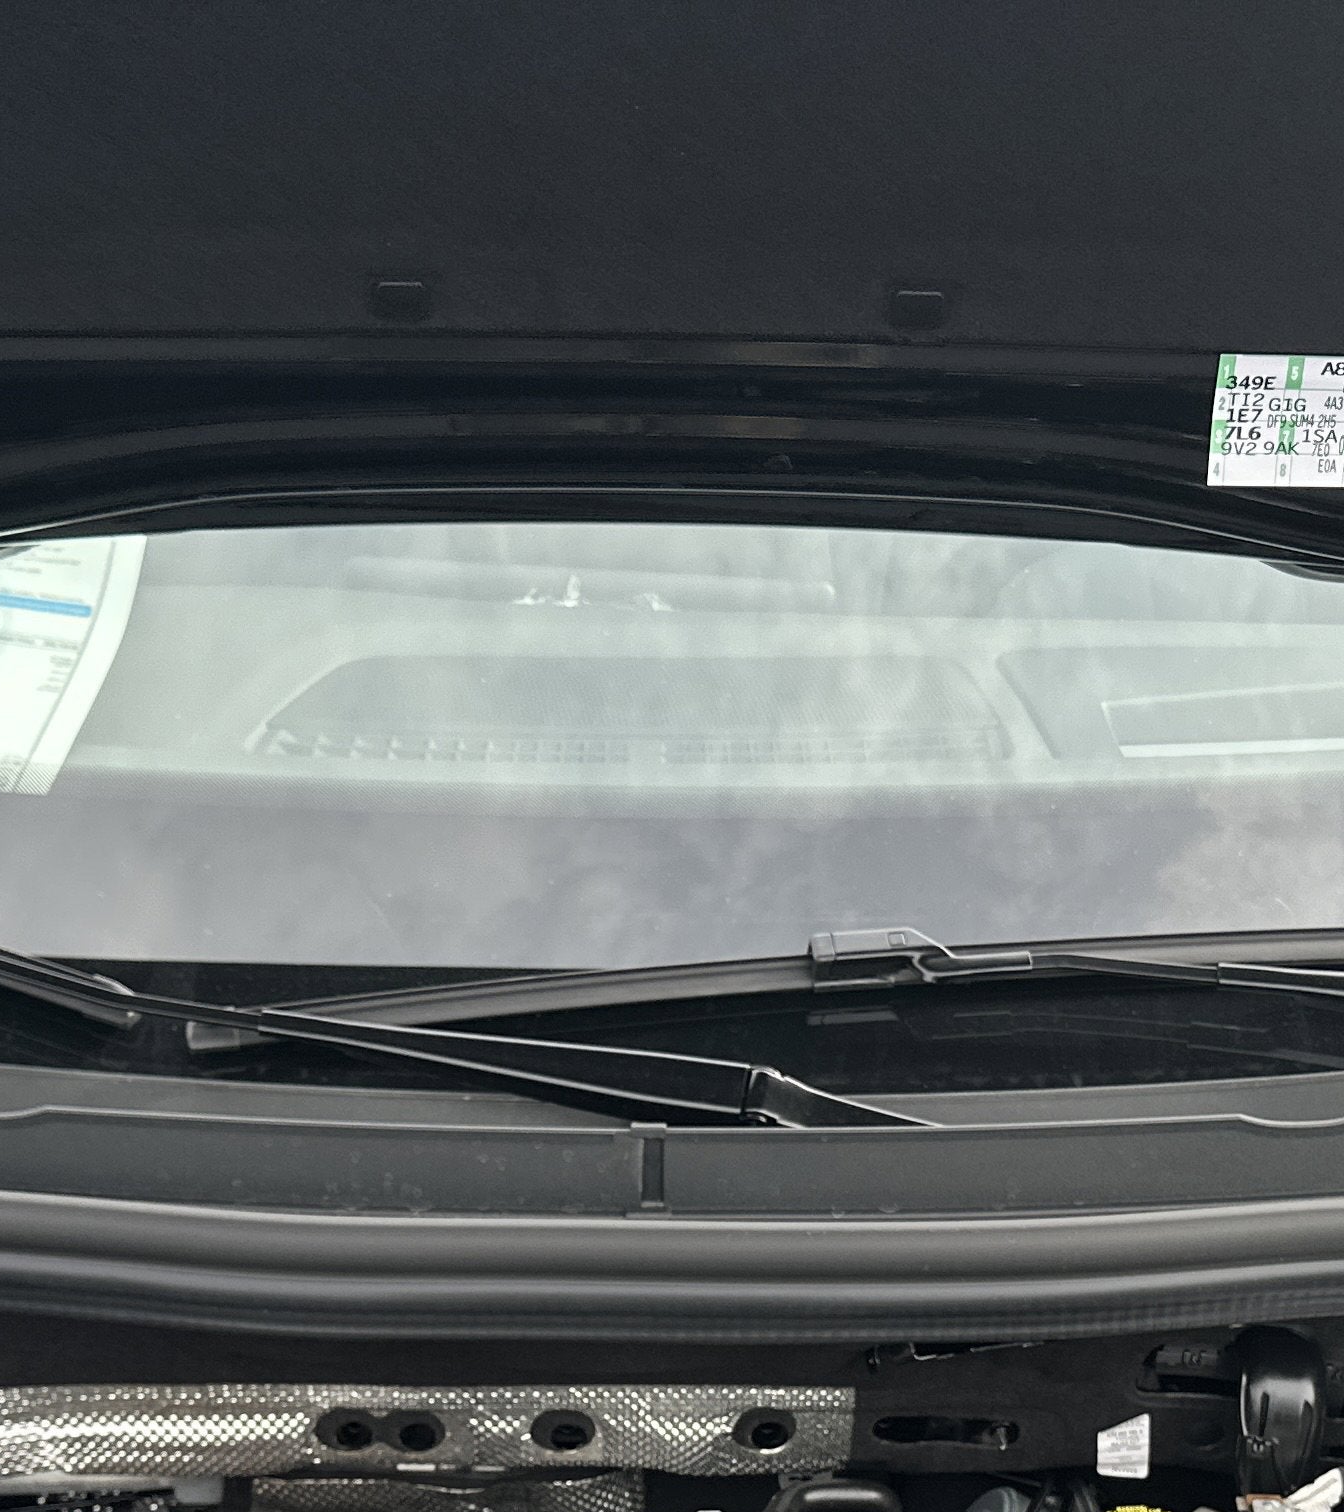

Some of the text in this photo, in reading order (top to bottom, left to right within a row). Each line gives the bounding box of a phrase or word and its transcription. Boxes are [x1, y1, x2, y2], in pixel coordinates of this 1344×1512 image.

[1225, 375, 1277, 390] 349E
[1324, 396, 1344, 410] 4A3
[1226, 408, 1263, 423] 1E7
[1224, 426, 1261, 440] 7L6
[1302, 428, 1338, 443] 1SA
[1221, 441, 1300, 456] 9V2 9AK
